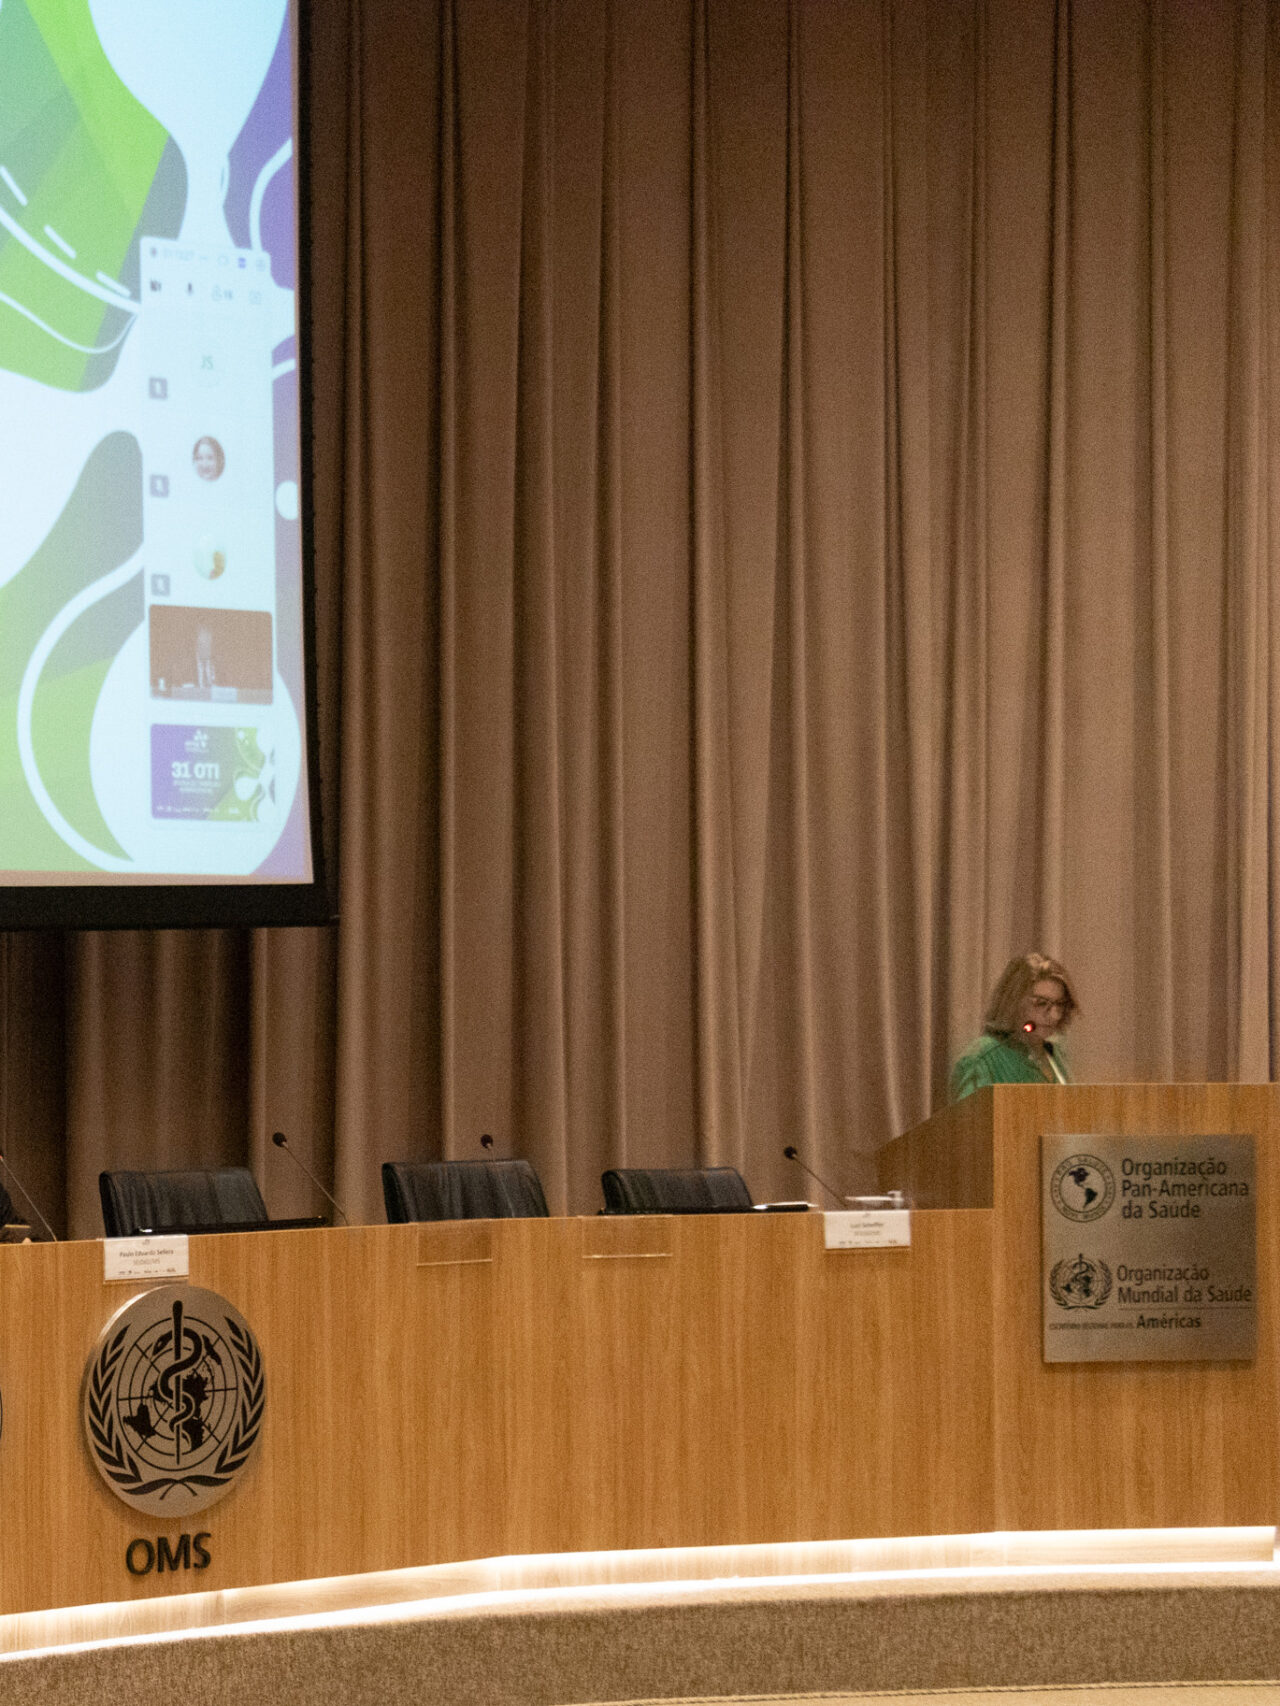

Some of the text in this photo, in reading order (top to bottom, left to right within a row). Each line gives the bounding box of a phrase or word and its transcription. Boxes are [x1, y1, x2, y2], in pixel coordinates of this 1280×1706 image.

[1121, 1157, 1228, 1180] Organização
[1122, 1177, 1249, 1198] Pan-Americana
[1122, 1200, 1143, 1219] da
[1149, 1200, 1201, 1219] Saúde
[1117, 1263, 1209, 1285] Organização
[1118, 1284, 1252, 1303] Mundial da Saúde
[1136, 1313, 1201, 1330] Américas
[125, 1532, 212, 1576] OMS
